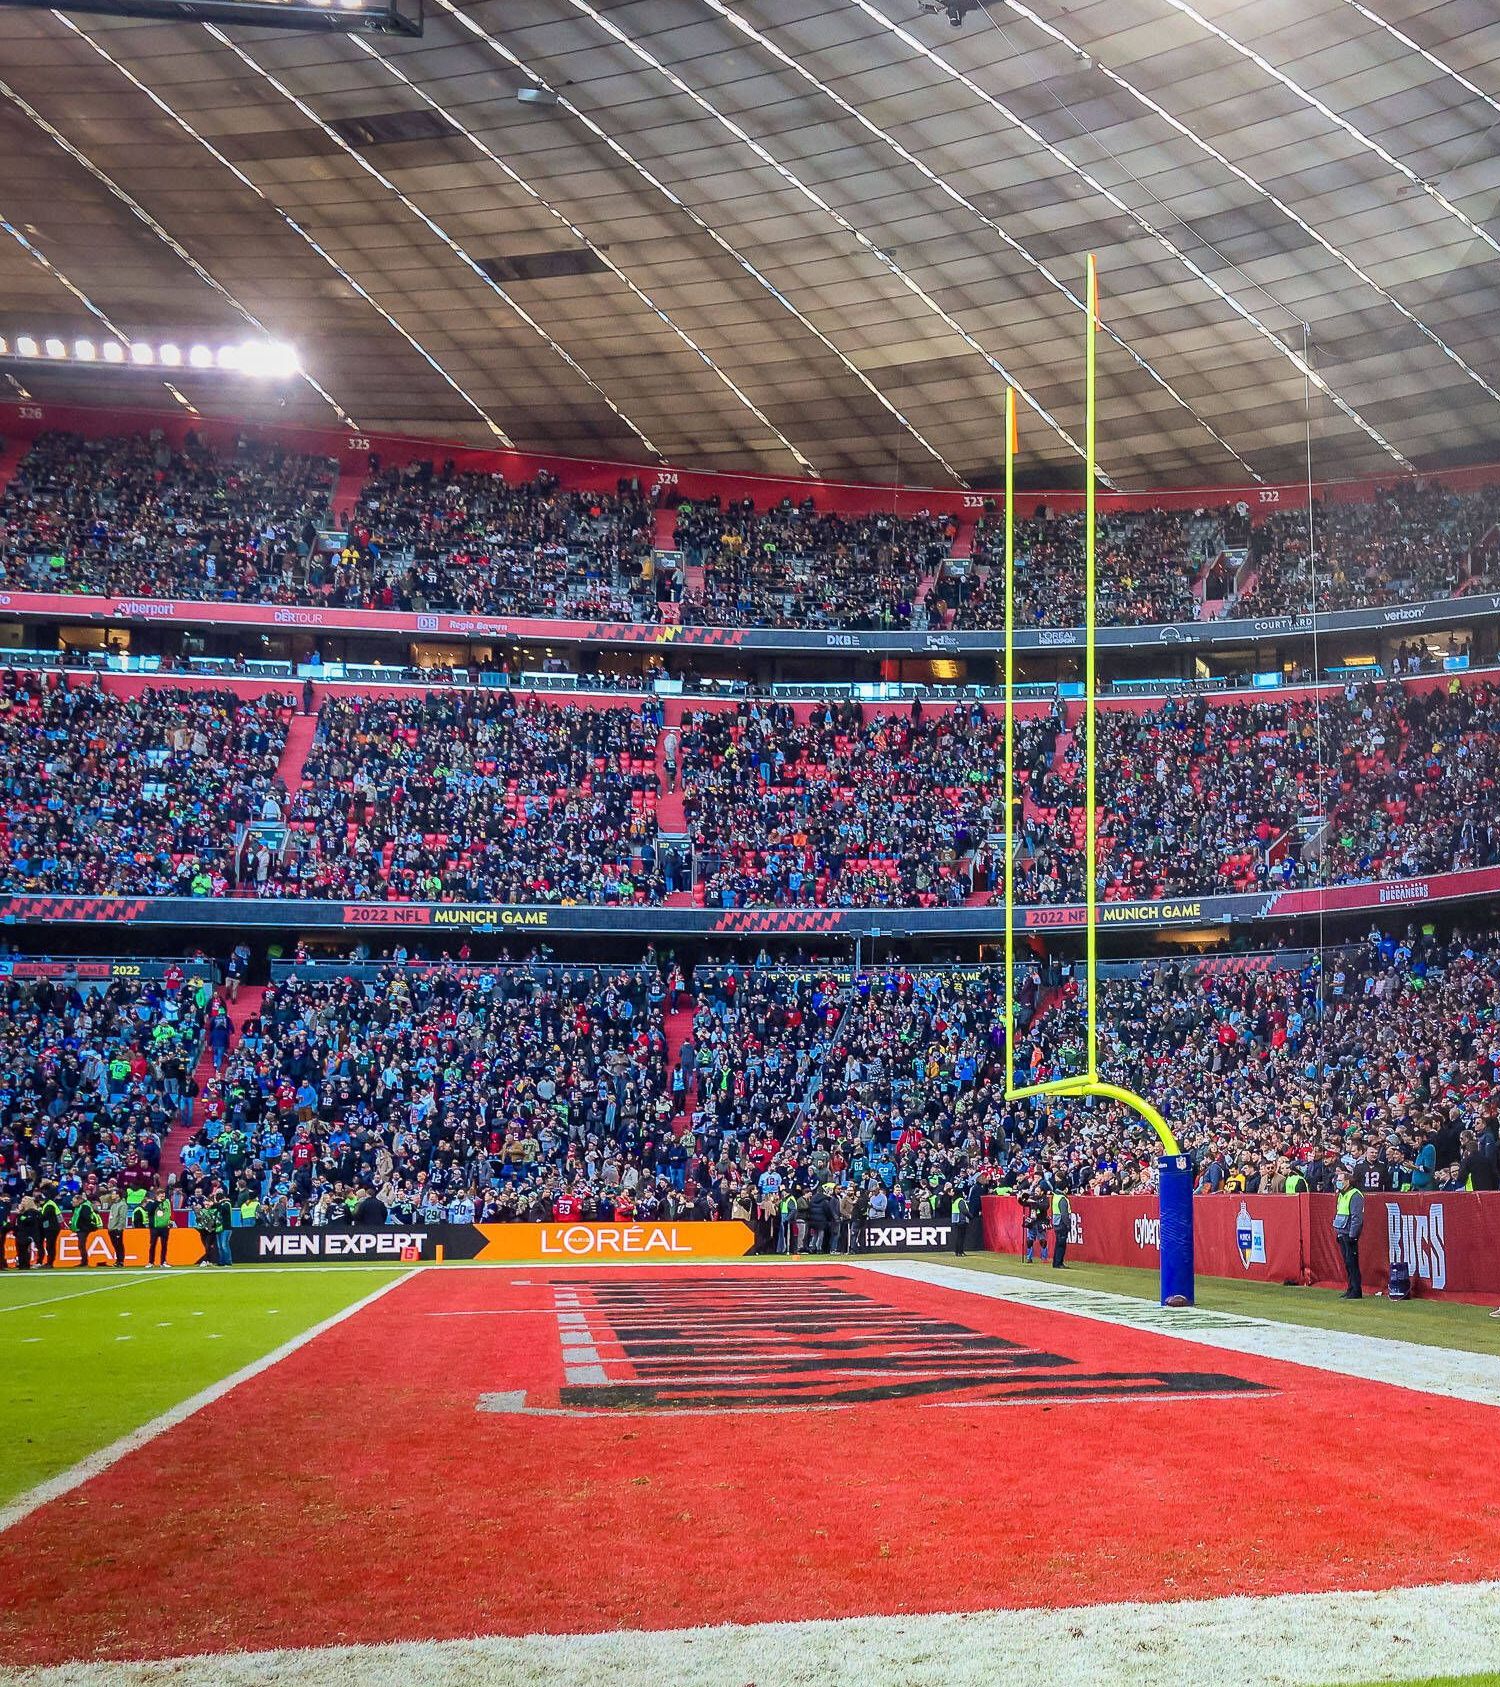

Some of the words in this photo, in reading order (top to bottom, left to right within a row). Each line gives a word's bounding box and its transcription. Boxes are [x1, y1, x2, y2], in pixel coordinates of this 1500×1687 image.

[19, 407, 42, 419] 326
[348, 439, 369, 450] 325
[657, 473, 679, 485] 324
[963, 496, 983, 508] 323
[1259, 491, 1279, 503] 322
[118, 602, 175, 616] cyberport
[1384, 609, 1422, 622] verizon
[274, 609, 323, 624] DERTOUR
[418, 617, 438, 630] DB
[450, 620, 476, 632] Regio
[1254, 617, 1313, 630] COURTYARD
[827, 635, 851, 646] DKB
[1379, 885, 1429, 903] BUCCANEERS
[352, 909, 388, 922] 2022
[392, 909, 423, 922] NFL
[434, 909, 498, 924] MUNICH
[501, 911, 548, 925] GAME
[1032, 912, 1064, 924] 2022
[1068, 910, 1088, 922] NF
[1103, 906, 1159, 922] MUNICH
[1162, 903, 1200, 918] GAME
[113, 966, 140, 976] 2022
[297, 1149, 308, 1159] 12
[1365, 1171, 1379, 1187] 12
[426, 1209, 438, 1221] 29
[559, 1203, 571, 1215] 23
[866, 1226, 951, 1247] EXPERT
[1134, 1213, 1160, 1251] cyberp
[260, 1234, 319, 1255] MEN
[325, 1232, 427, 1255] EXPERT
[541, 1225, 692, 1255] L'ORÉAL
[1385, 1202, 1446, 1290] BUCS
